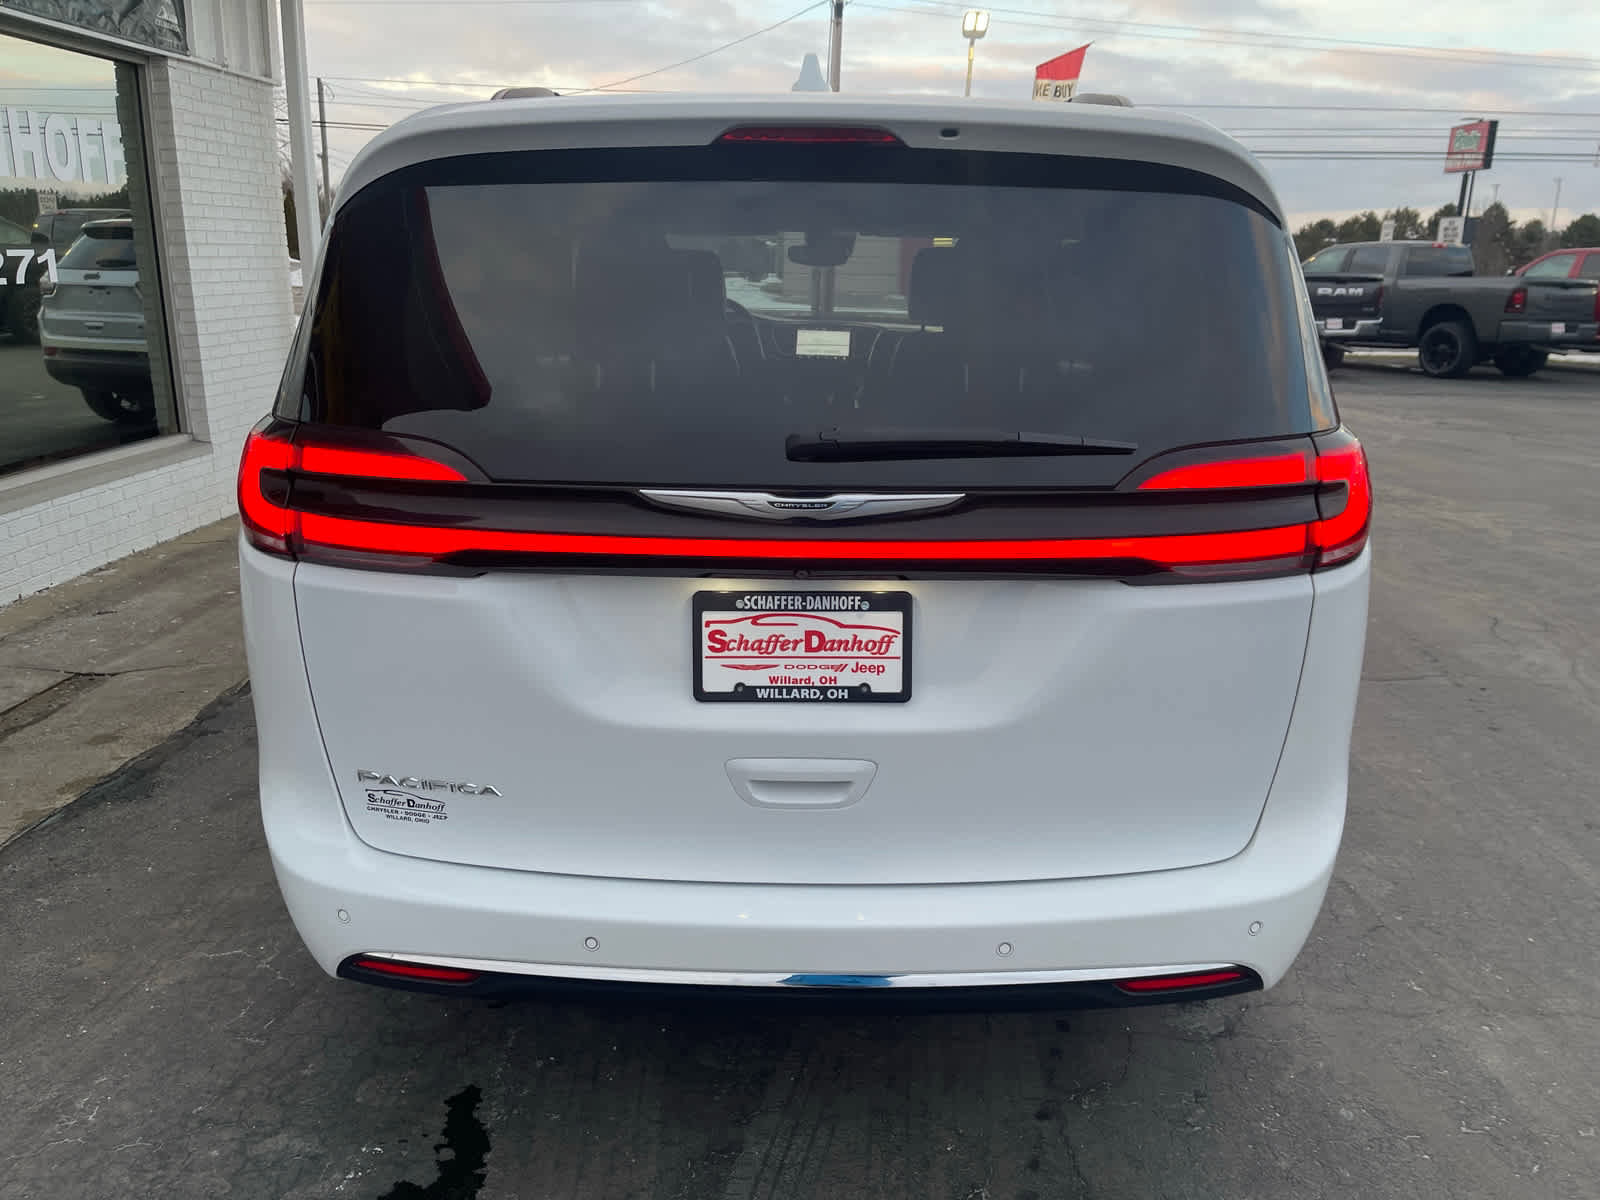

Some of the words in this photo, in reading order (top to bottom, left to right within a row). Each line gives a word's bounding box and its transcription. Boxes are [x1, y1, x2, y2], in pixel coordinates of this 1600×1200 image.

[1317, 287, 1364, 296] RAM
[743, 595, 861, 611] SCHAFFER-DANHOFF
[707, 629, 803, 655] Schaffer
[804, 629, 899, 656] Danhoff
[784, 663, 839, 671] DODGE
[851, 661, 886, 676] Jeep
[768, 675, 816, 686] Willard,
[819, 676, 838, 685] OH
[756, 688, 824, 701] WILLARD,
[827, 688, 849, 700] OH
[357, 768, 503, 797] PACIFICA
[367, 792, 407, 807] Schaffer
[406, 799, 446, 812] Danhoff
[366, 805, 399, 815] CHRYSLER
[404, 811, 427, 819] DODGE
